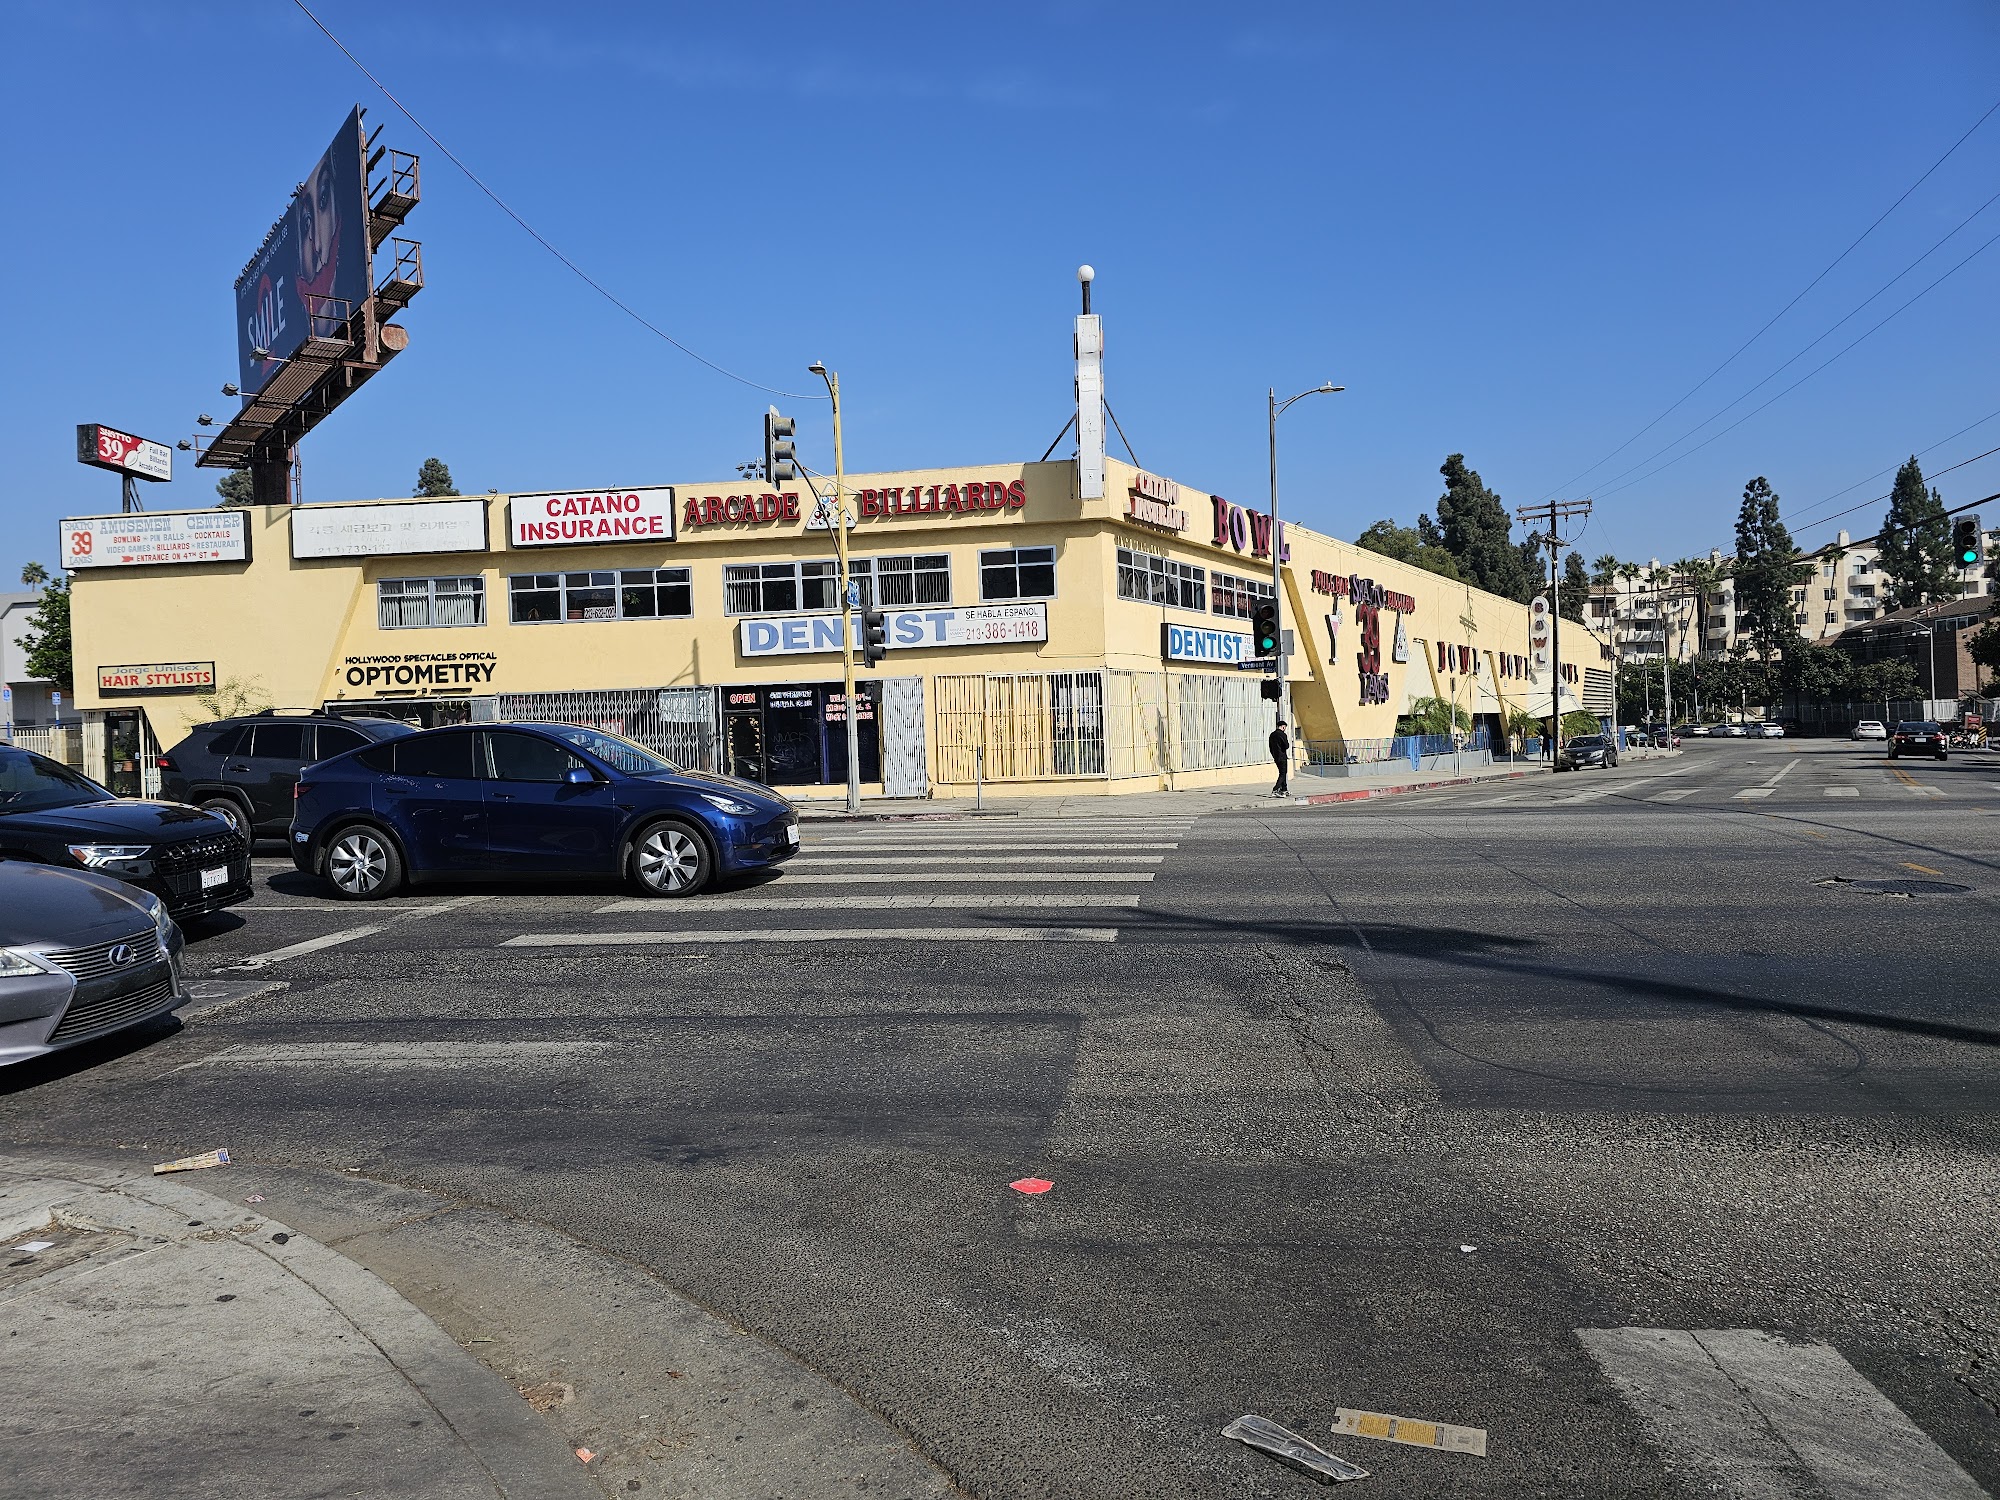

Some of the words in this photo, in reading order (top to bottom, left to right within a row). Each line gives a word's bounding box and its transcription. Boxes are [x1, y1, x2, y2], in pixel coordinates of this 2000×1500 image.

[248, 275, 286, 367] SMILE
[100, 427, 132, 444] SHATTO
[99, 435, 124, 460] 39
[153, 464, 169, 476] Games
[684, 492, 801, 526] ARCADE
[860, 479, 1027, 517] BILLIARDS
[186, 513, 241, 530] CENTER
[1130, 495, 1191, 533] INSURANCE
[64, 521, 94, 532] SHATTO
[520, 515, 664, 542] INSURANCE
[1210, 495, 1291, 564] BOWL
[71, 531, 93, 556] 39
[113, 535, 141, 544] BOWLING
[150, 534, 161, 542] PIN
[163, 533, 185, 541] BALLS
[194, 530, 231, 540] COCKTAILS
[106, 546, 126, 554] VIDEO
[128, 544, 151, 553] GAMES
[156, 542, 190, 551] BILLIARDS
[196, 540, 240, 549] RESTAURANT
[68, 554, 93, 566] LANES
[136, 553, 170, 562] ENTRANCE
[172, 552, 181, 560] ON
[198, 551, 208, 559] ST
[965, 610, 975, 620] SE
[977, 608, 1003, 619] HABLA
[1004, 605, 1038, 617] ESPAÑOL
[1356, 603, 1380, 675] 39
[1533, 601, 1548, 665] BOWL
[1171, 628, 1242, 660] DENTIST
[345, 656, 401, 665] HOLLYWOOD
[404, 653, 458, 662] SPECTACLES
[459, 652, 497, 660] OPTICAL
[1241, 661, 1265, 669] Vermont
[1437, 641, 1481, 675] BOWL
[155, 664, 200, 673] Unisex
[346, 662, 497, 686] OPTOMETRY
[102, 675, 139, 687] HAIR
[146, 671, 211, 685] STYLISTS
[729, 693, 756, 704] OPEN
